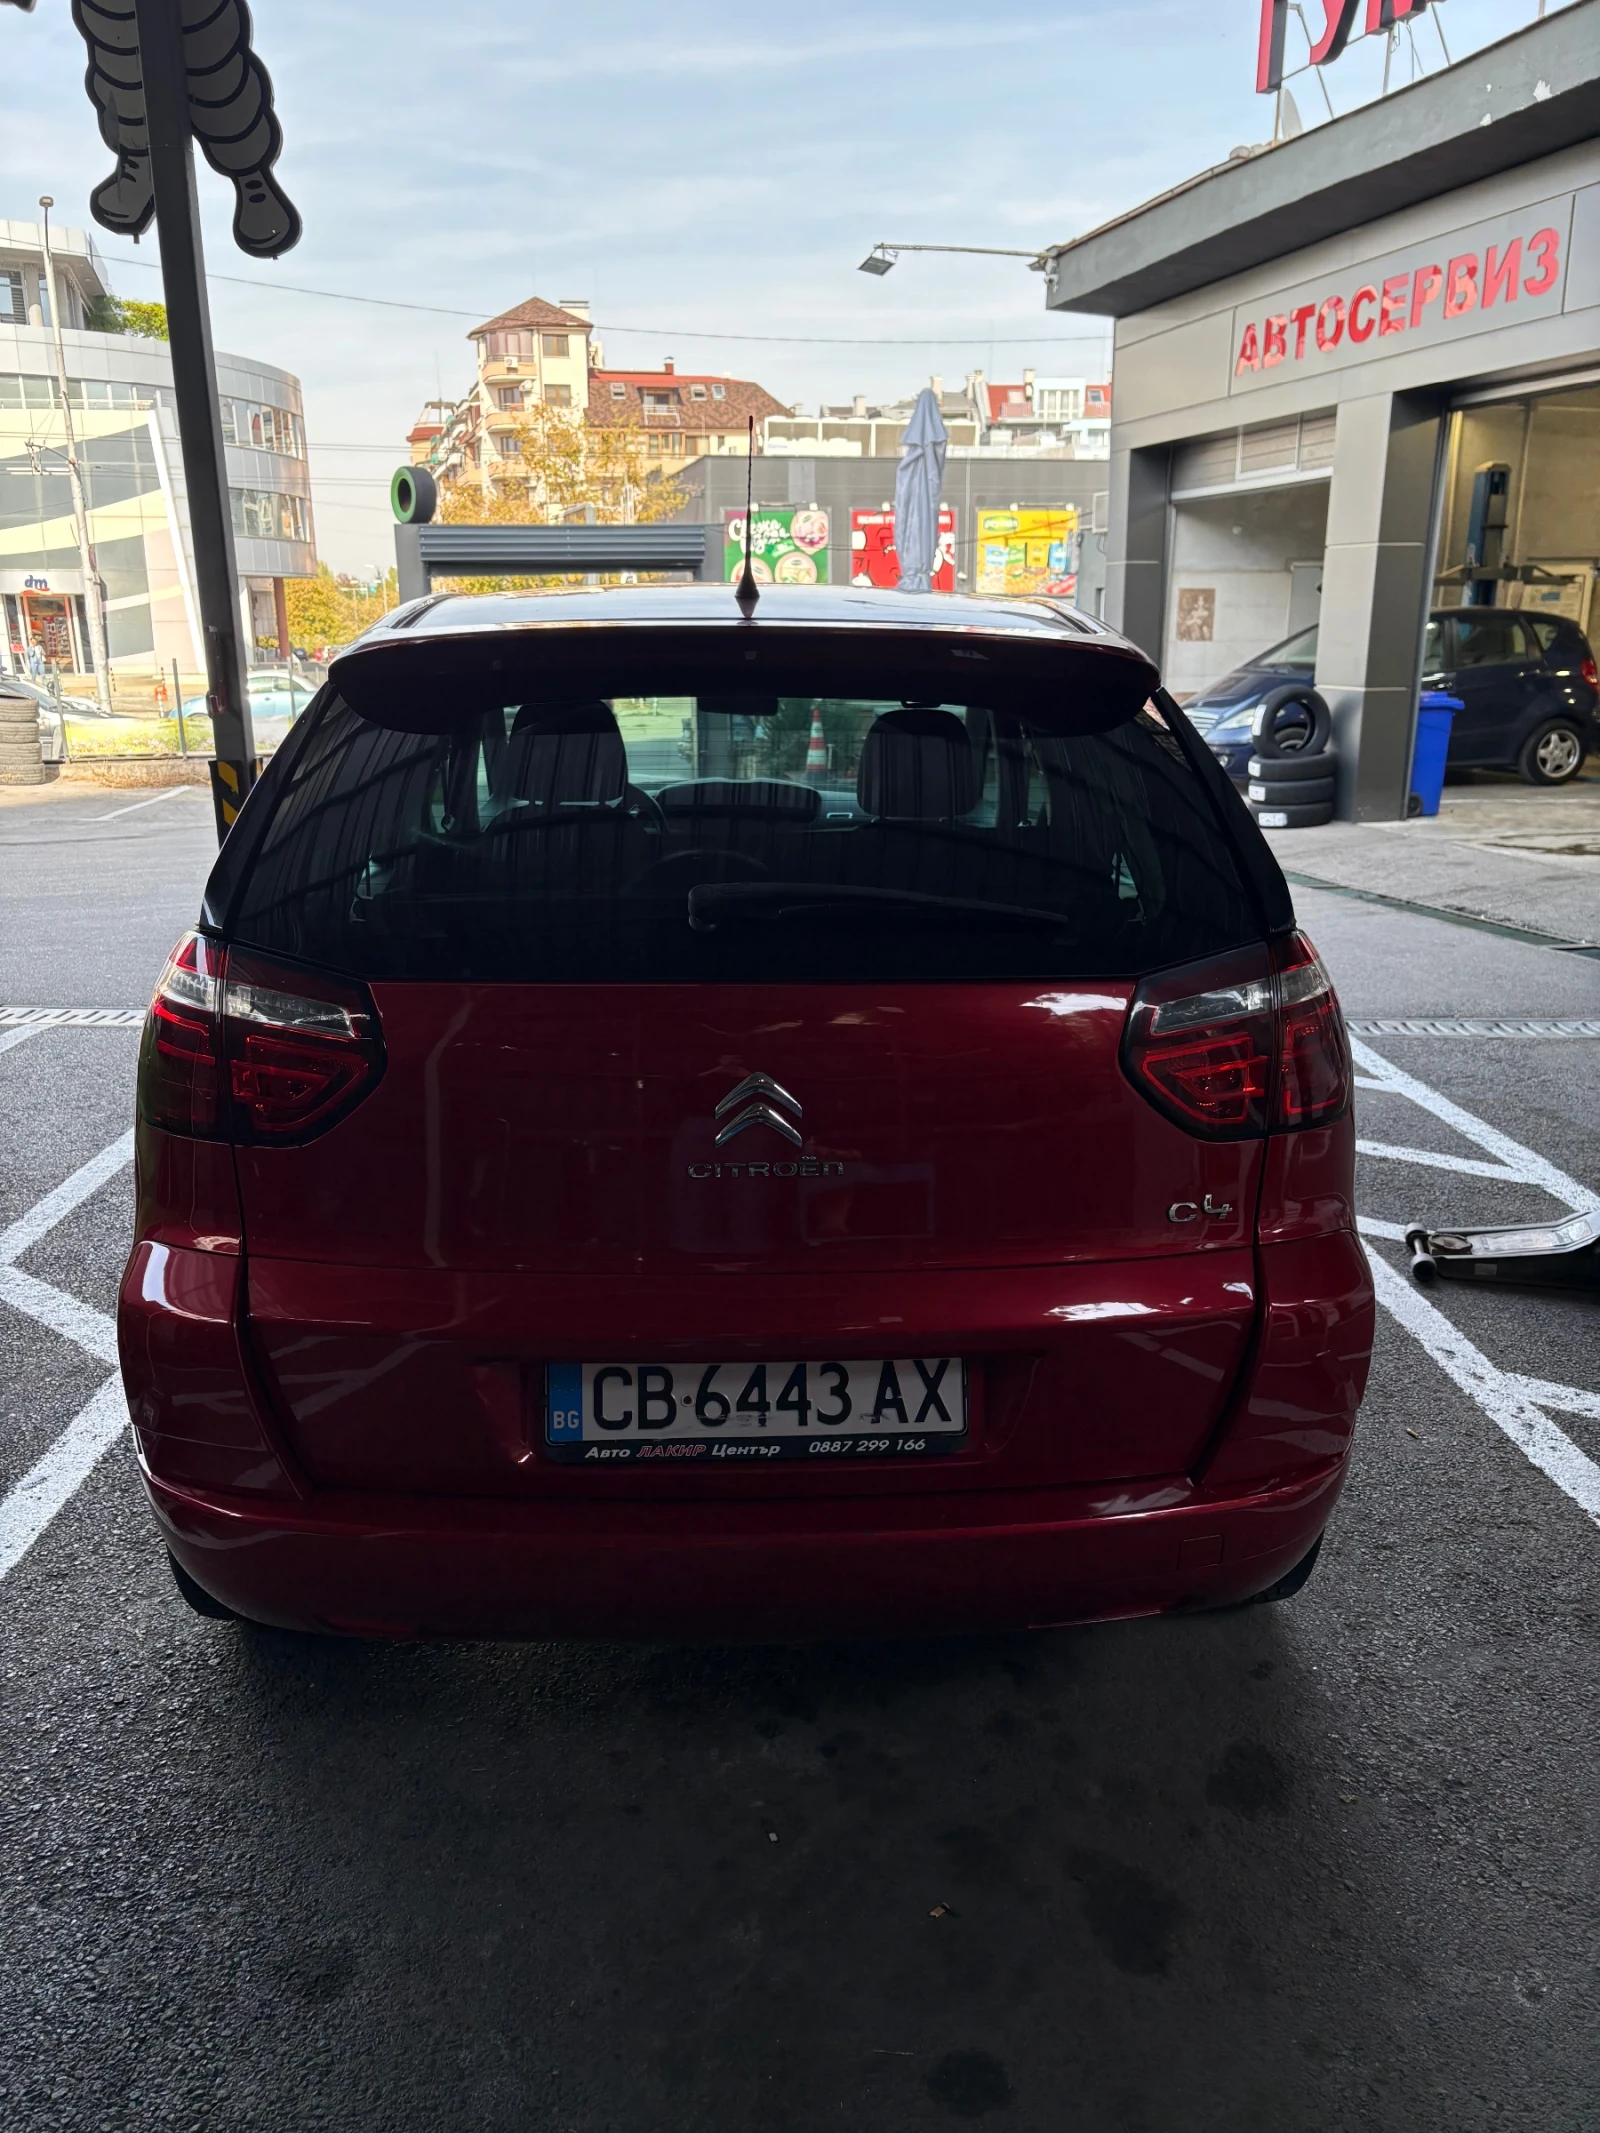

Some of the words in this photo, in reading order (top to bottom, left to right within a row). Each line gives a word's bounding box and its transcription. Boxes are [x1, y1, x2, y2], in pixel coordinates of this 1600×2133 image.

[1235, 227, 1560, 376] АВТОСЕРВИЗ
[24, 574, 48, 589] dm
[1168, 1193, 1233, 1223] C4
[592, 1365, 678, 1430] CB
[695, 1362, 852, 1427] 6443
[872, 1358, 952, 1424] AX
[553, 1410, 579, 1430] BG
[584, 1444, 631, 1459] Авто
[635, 1443, 707, 1458] ЛАКИР
[711, 1442, 781, 1458] Център
[808, 1440, 852, 1454] 0887
[856, 1439, 890, 1453] 299
[895, 1438, 926, 1452] 166
